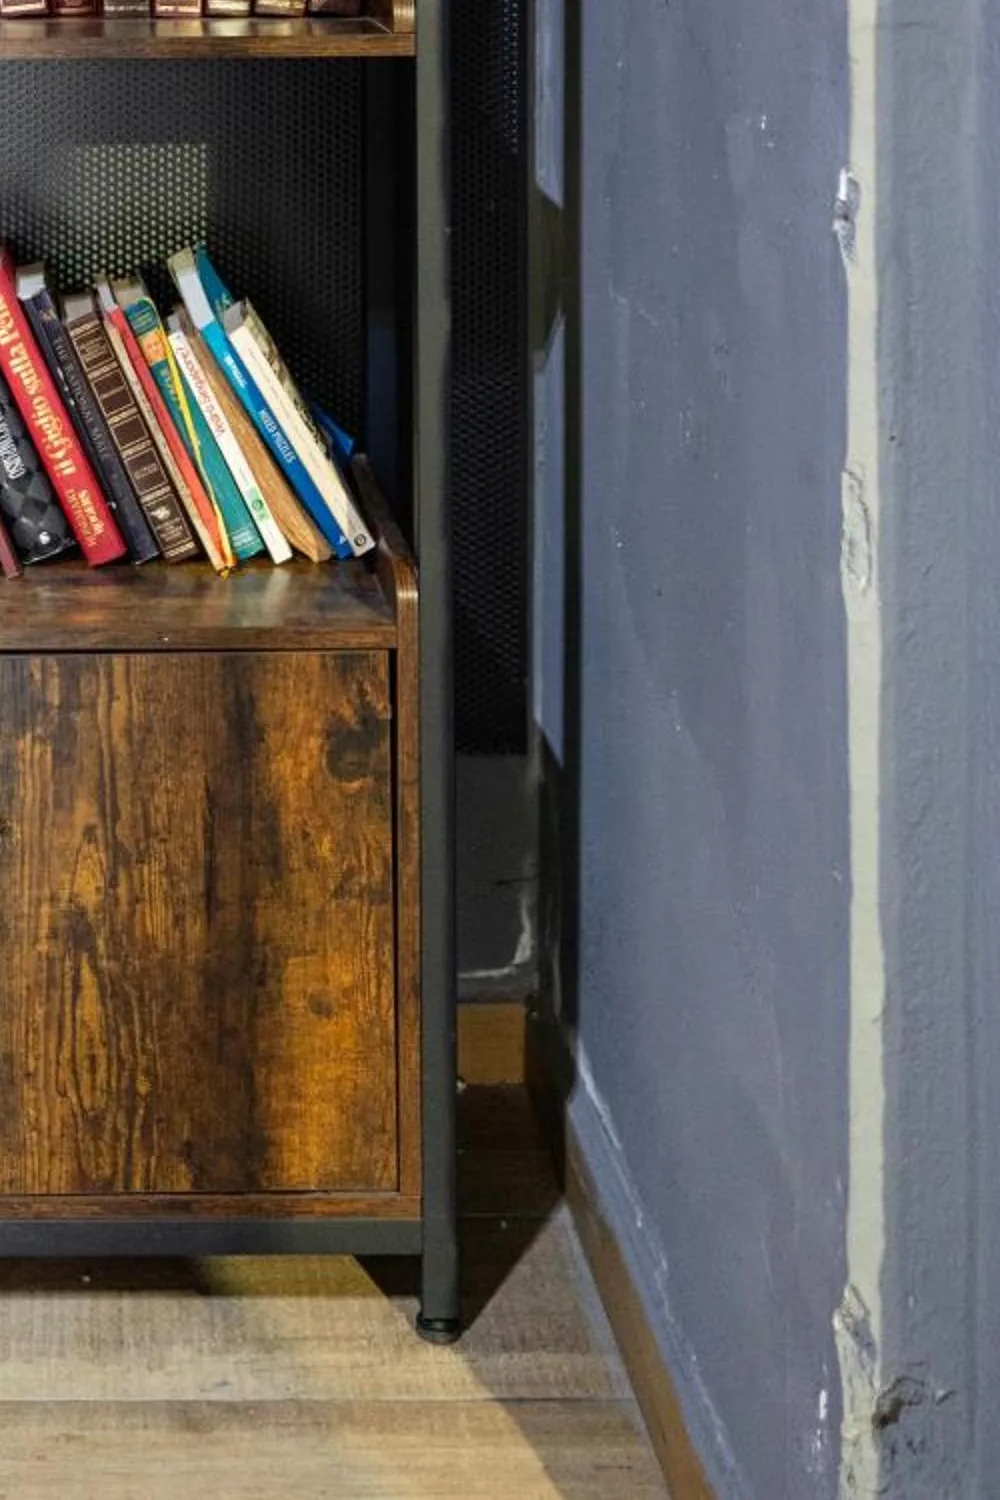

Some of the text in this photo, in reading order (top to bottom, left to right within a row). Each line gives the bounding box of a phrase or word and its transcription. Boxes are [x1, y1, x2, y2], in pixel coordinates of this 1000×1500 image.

[7, 343, 41, 397] sulla
[31, 394, 73, 460] Giglio
[270, 431, 295, 465] PUZZLES
